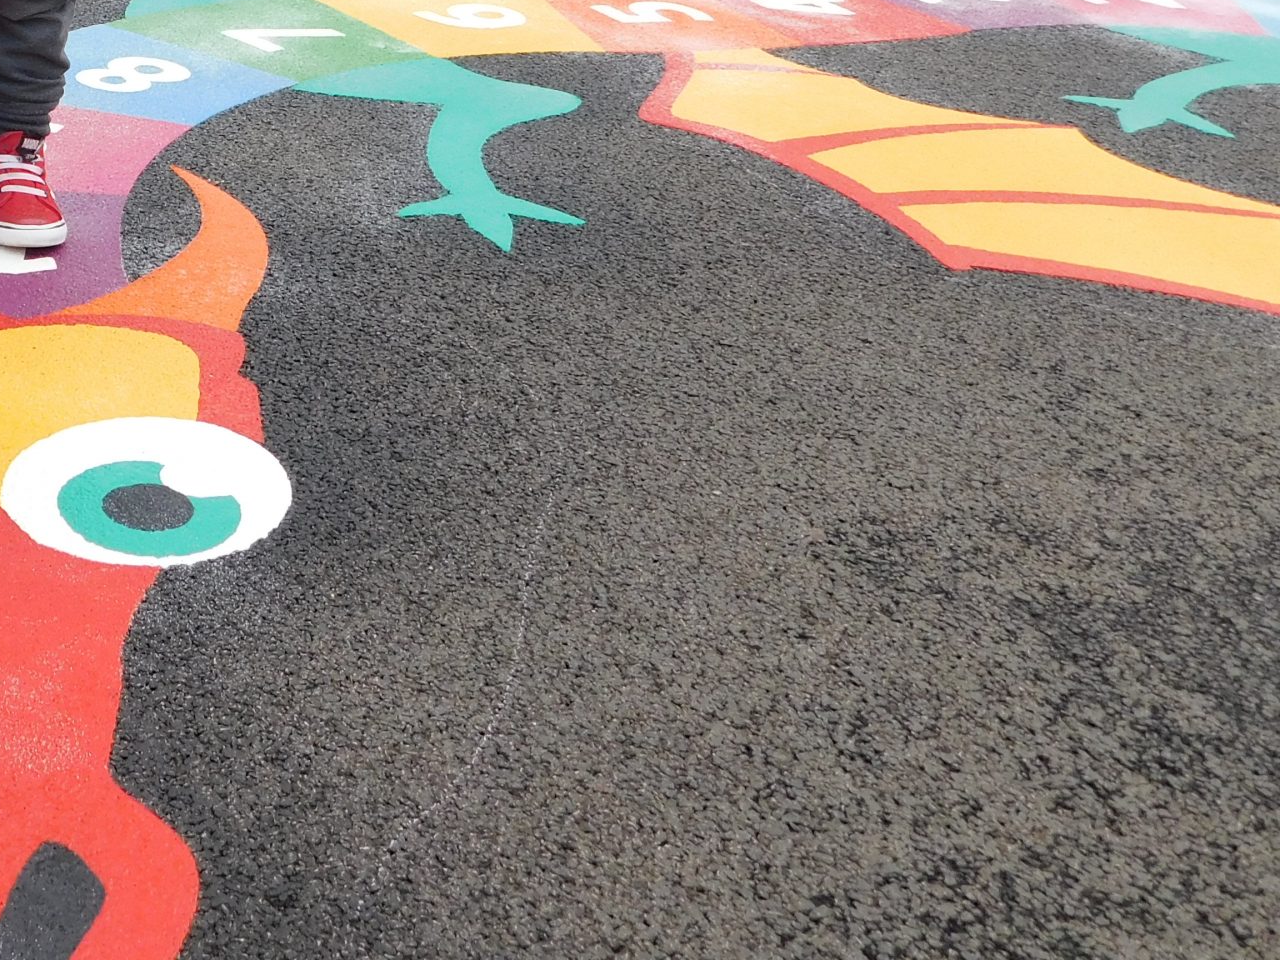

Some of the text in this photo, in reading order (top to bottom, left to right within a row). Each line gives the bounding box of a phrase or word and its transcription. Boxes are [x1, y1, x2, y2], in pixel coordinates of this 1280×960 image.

[414, 4, 526, 28] 6
[590, 1, 714, 24] 5
[222, 29, 345, 51] 7
[75, 57, 191, 92] 8
